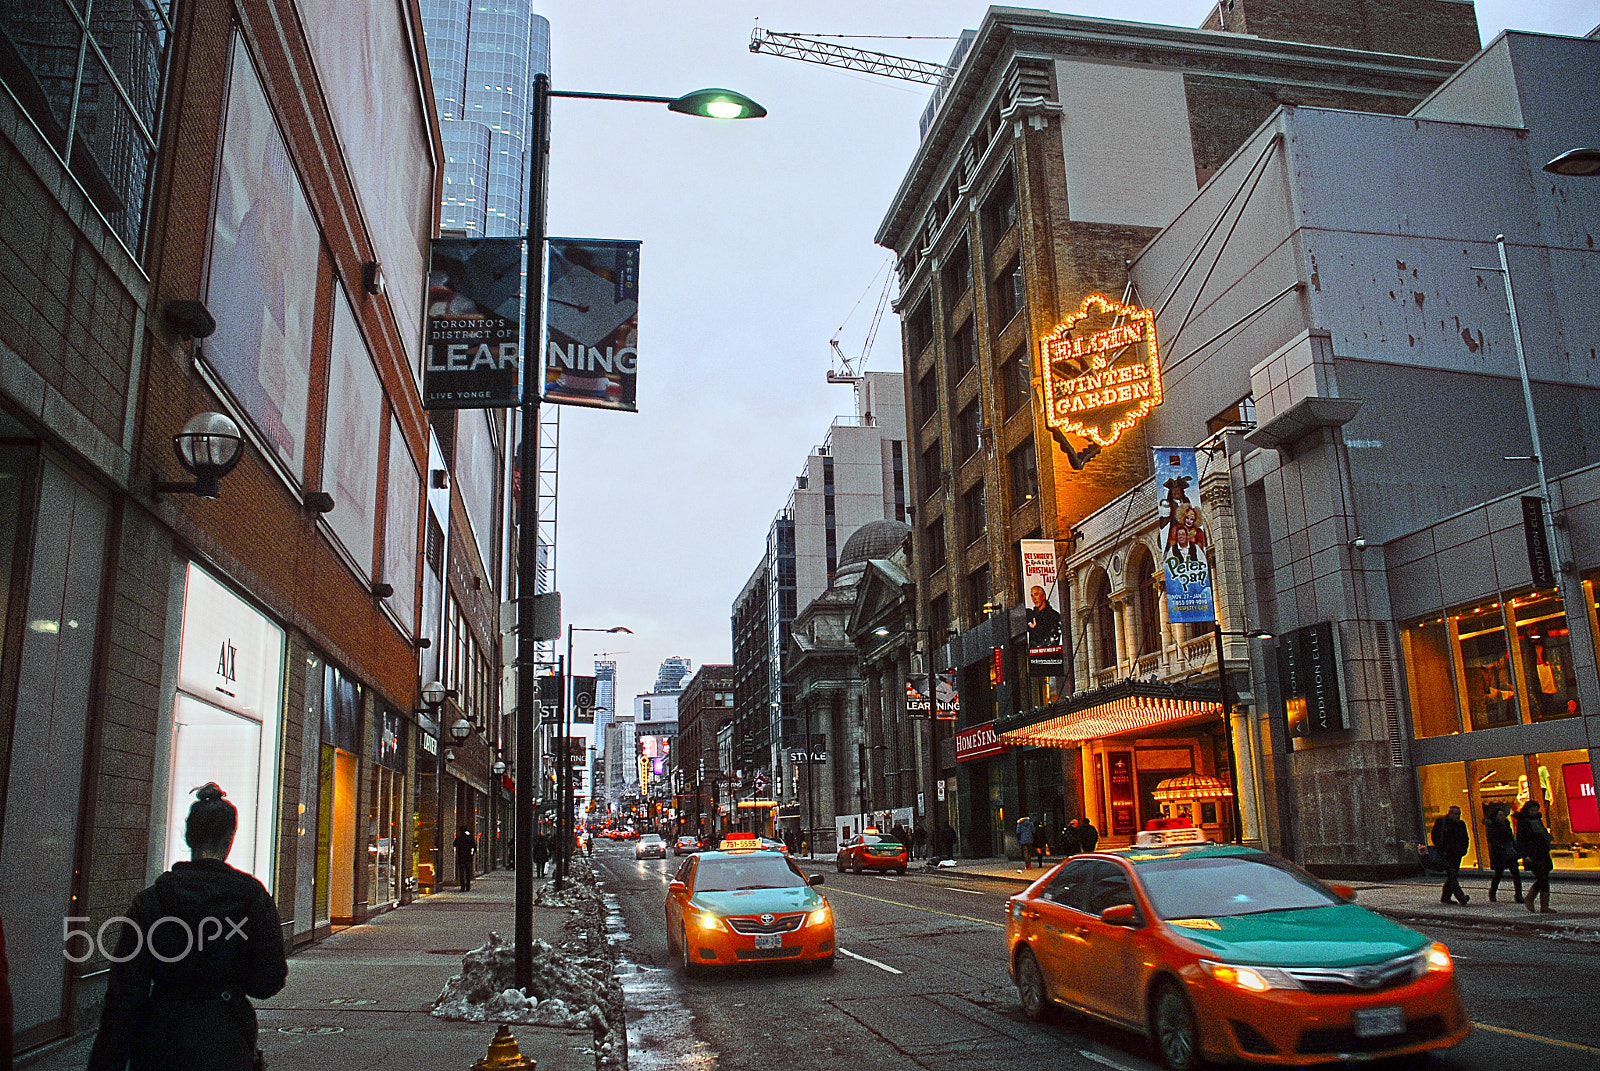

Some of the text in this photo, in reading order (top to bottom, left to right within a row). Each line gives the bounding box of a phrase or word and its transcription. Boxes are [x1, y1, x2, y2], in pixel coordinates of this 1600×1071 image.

[432, 330, 512, 339] DISTRICT OF
[433, 319, 505, 329] TORONTO'S
[1051, 321, 1145, 362] ELGIN
[1091, 354, 1108, 371] &
[1053, 363, 1151, 396] WINTER
[457, 391, 491, 399] YONGE
[1056, 381, 1151, 415] GARDEN
[1528, 502, 1546, 582] ADDITION ELLE
[1026, 565, 1055, 576] CHRISTMAS
[1165, 556, 1207, 579] Peter
[1180, 571, 1207, 591] Pan
[1310, 628, 1328, 729] ADDITION ELLE
[956, 729, 997, 752] HOMESENS
